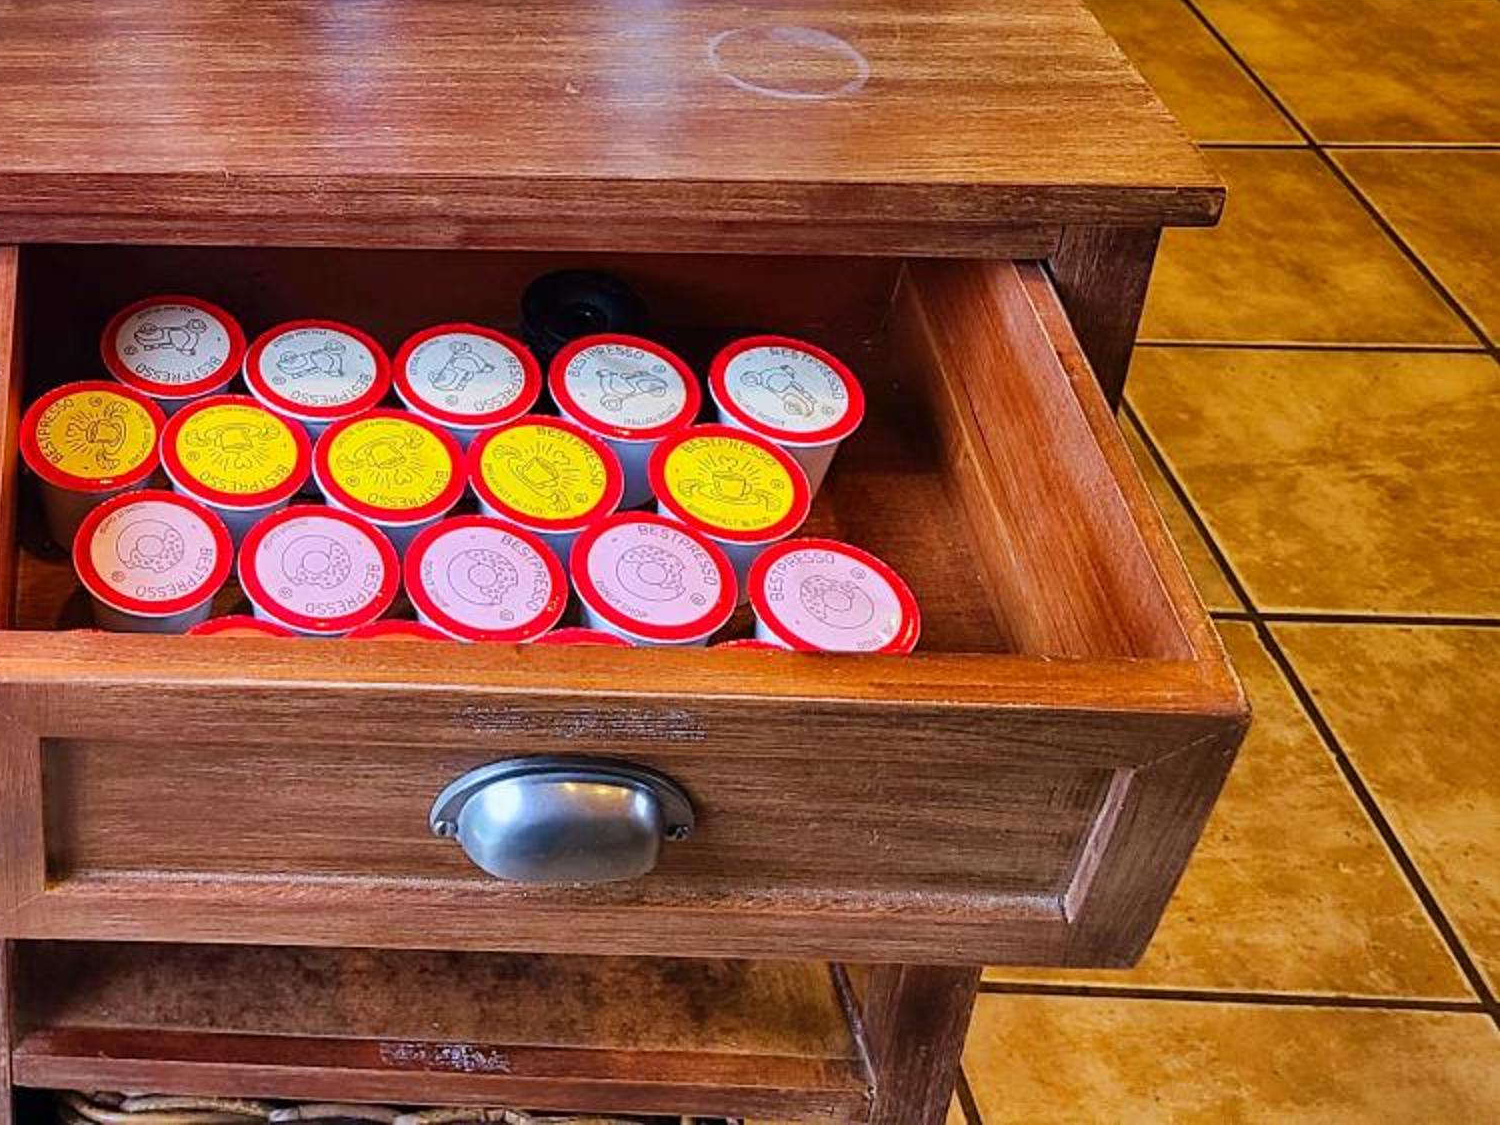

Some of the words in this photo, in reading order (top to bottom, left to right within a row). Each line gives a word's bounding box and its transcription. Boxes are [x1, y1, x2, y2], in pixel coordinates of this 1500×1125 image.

[567, 346, 645, 378] BESTPRESSO
[291, 374, 373, 405] BESTPRESSO
[38, 398, 75, 464] BESTPRESSO
[536, 426, 603, 487] BESTPRESSO
[682, 438, 777, 468] BESTPRESSO
[199, 464, 290, 492] BESTPRESSO
[135, 547, 214, 599] BESTPRESSO
[501, 534, 549, 612] BESTPRESSO
[638, 524, 718, 587] BESTPRESSO
[767, 552, 835, 602] BESTPRESSO
[306, 562, 381, 615] BESTPRESSO
